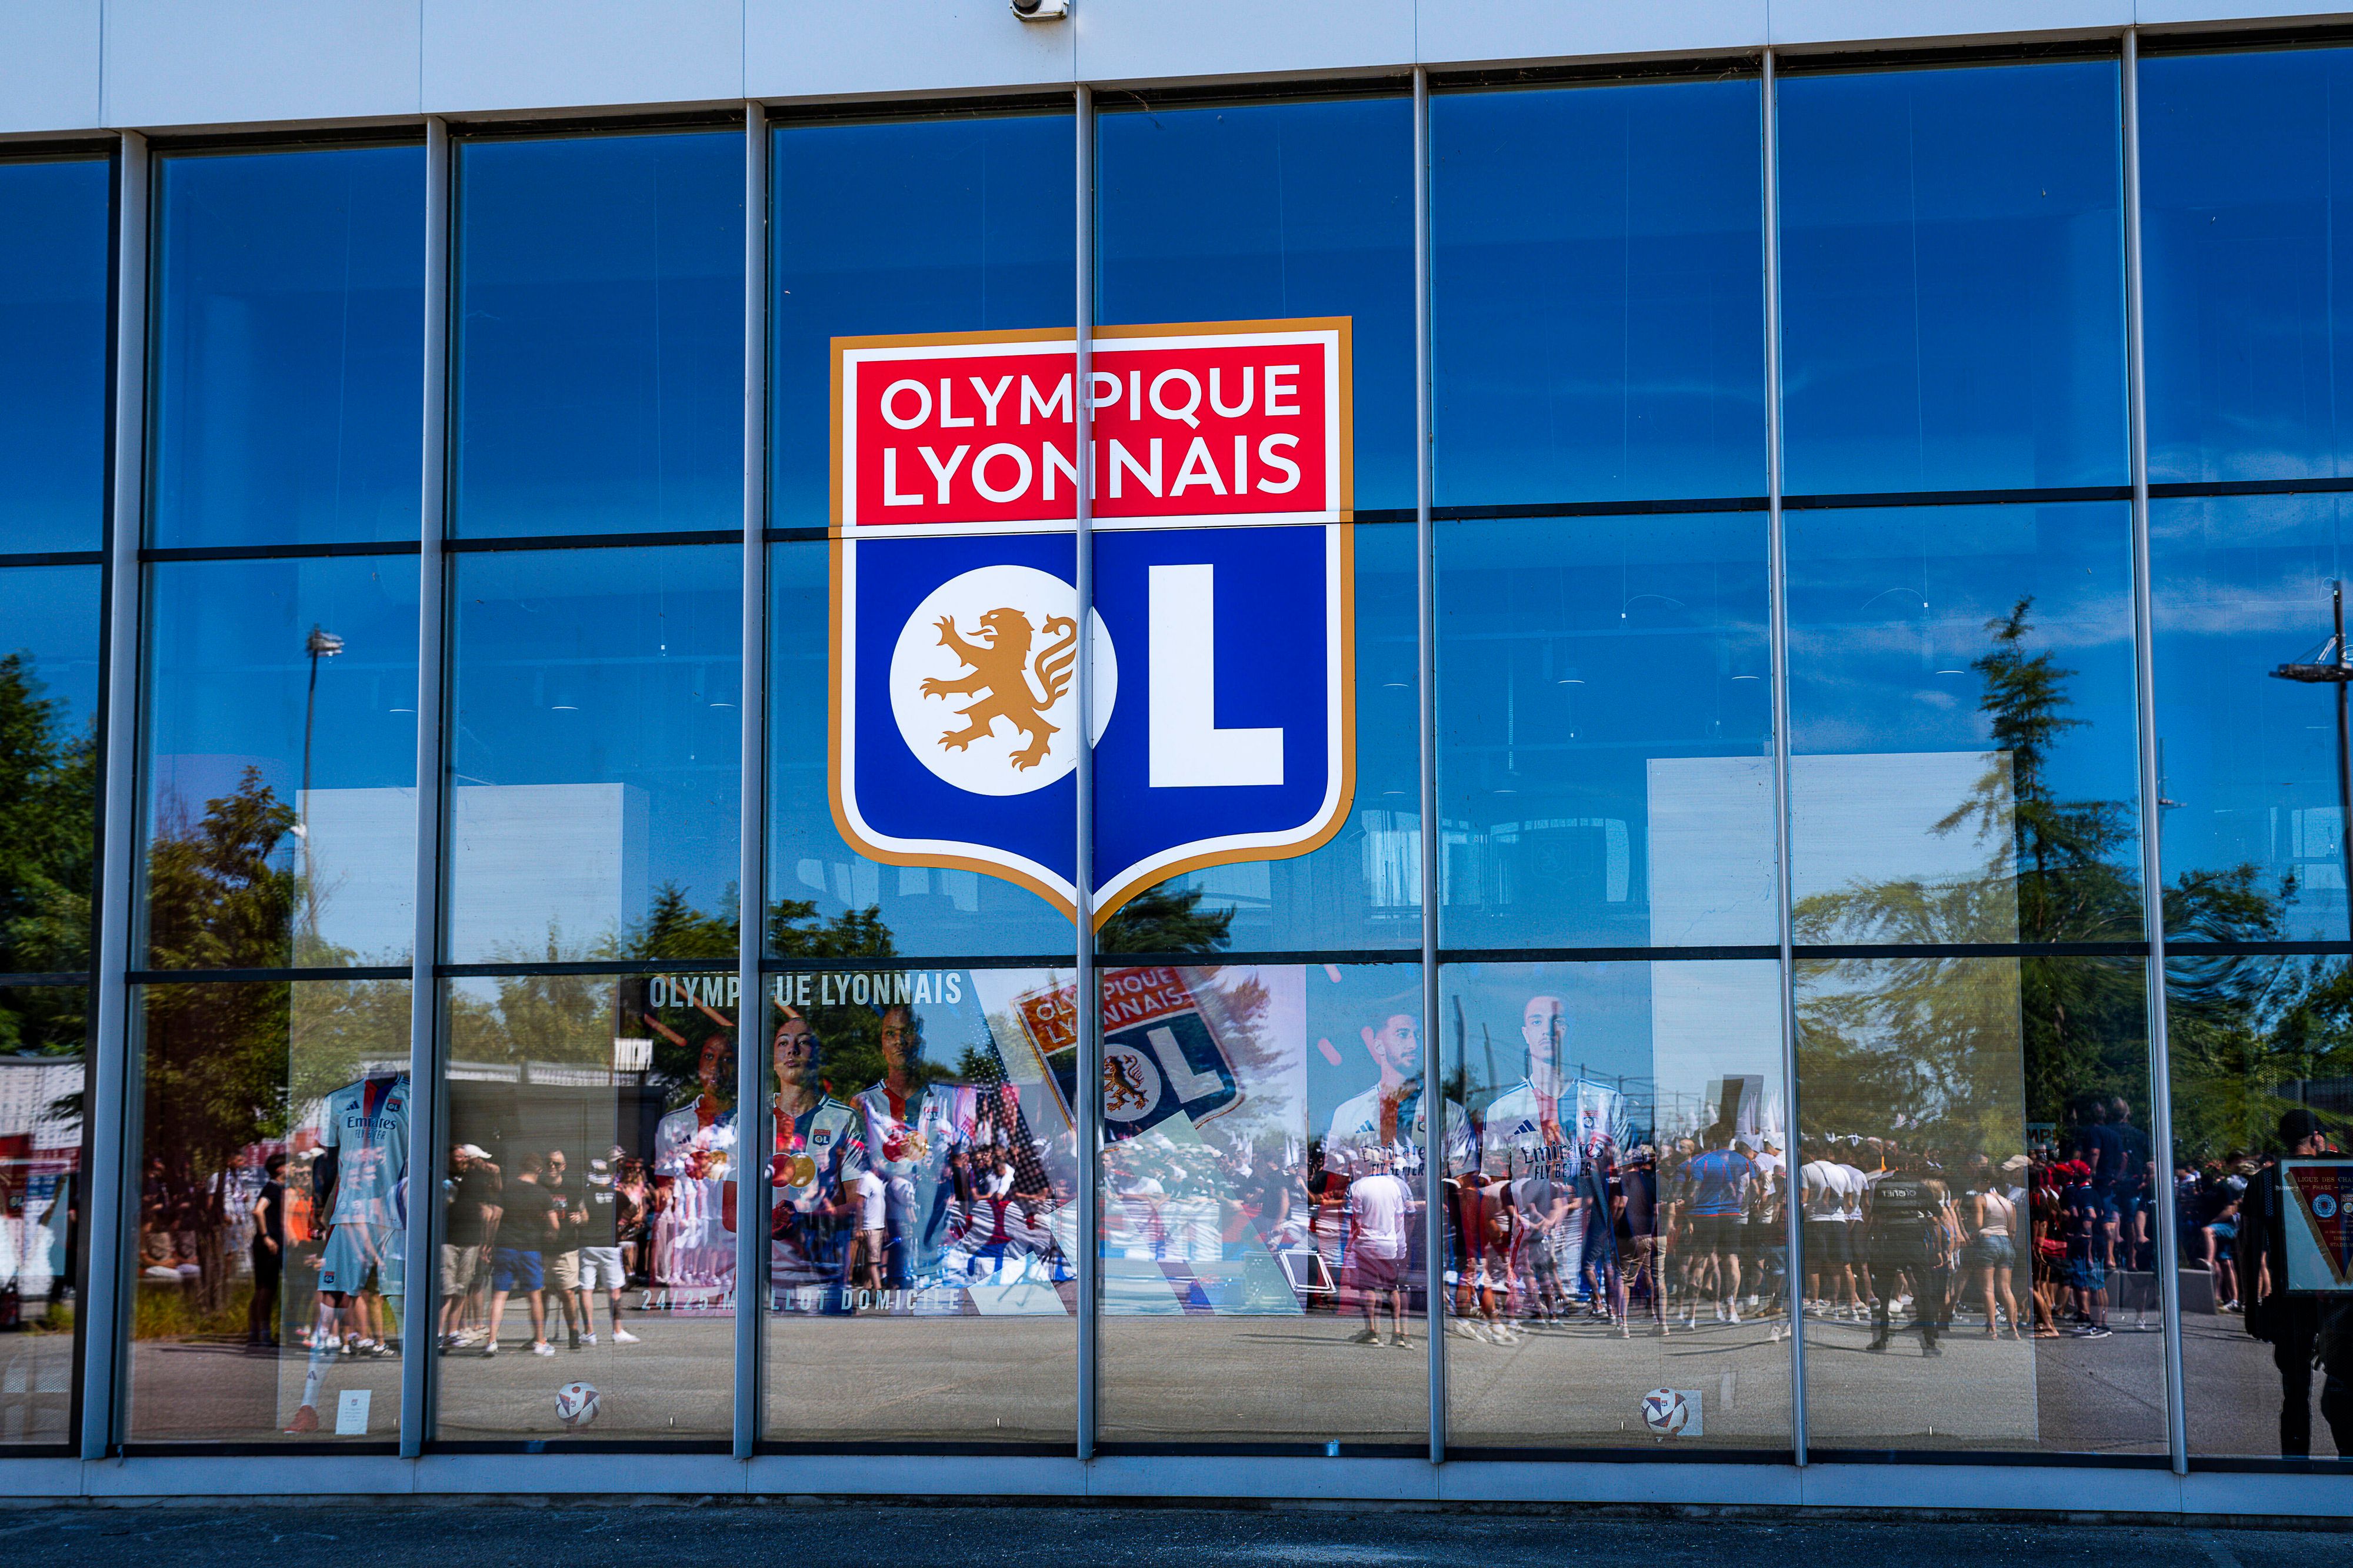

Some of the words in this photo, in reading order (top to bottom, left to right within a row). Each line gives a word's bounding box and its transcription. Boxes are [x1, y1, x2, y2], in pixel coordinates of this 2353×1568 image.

[881, 364, 1301, 429] OLYMPIQUE
[884, 433, 1300, 506] LYONNAIS
[889, 563, 1284, 796] OL
[649, 975, 811, 1007] OLYMPUE
[822, 972, 961, 1005] LYONNAIS
[1036, 968, 1175, 1022] OLYPIQUE
[1046, 987, 1184, 1043] LYNNAIS
[348, 1115, 396, 1130] Emirates
[1521, 1140, 1604, 1164] Emirates
[1534, 1165, 1551, 1180] FLY
[1555, 1162, 1592, 1178] BETTER
[642, 1289, 709, 1310] 24/25
[722, 1290, 828, 1310] MLLOT
[841, 1289, 960, 1310] DOMICILE
